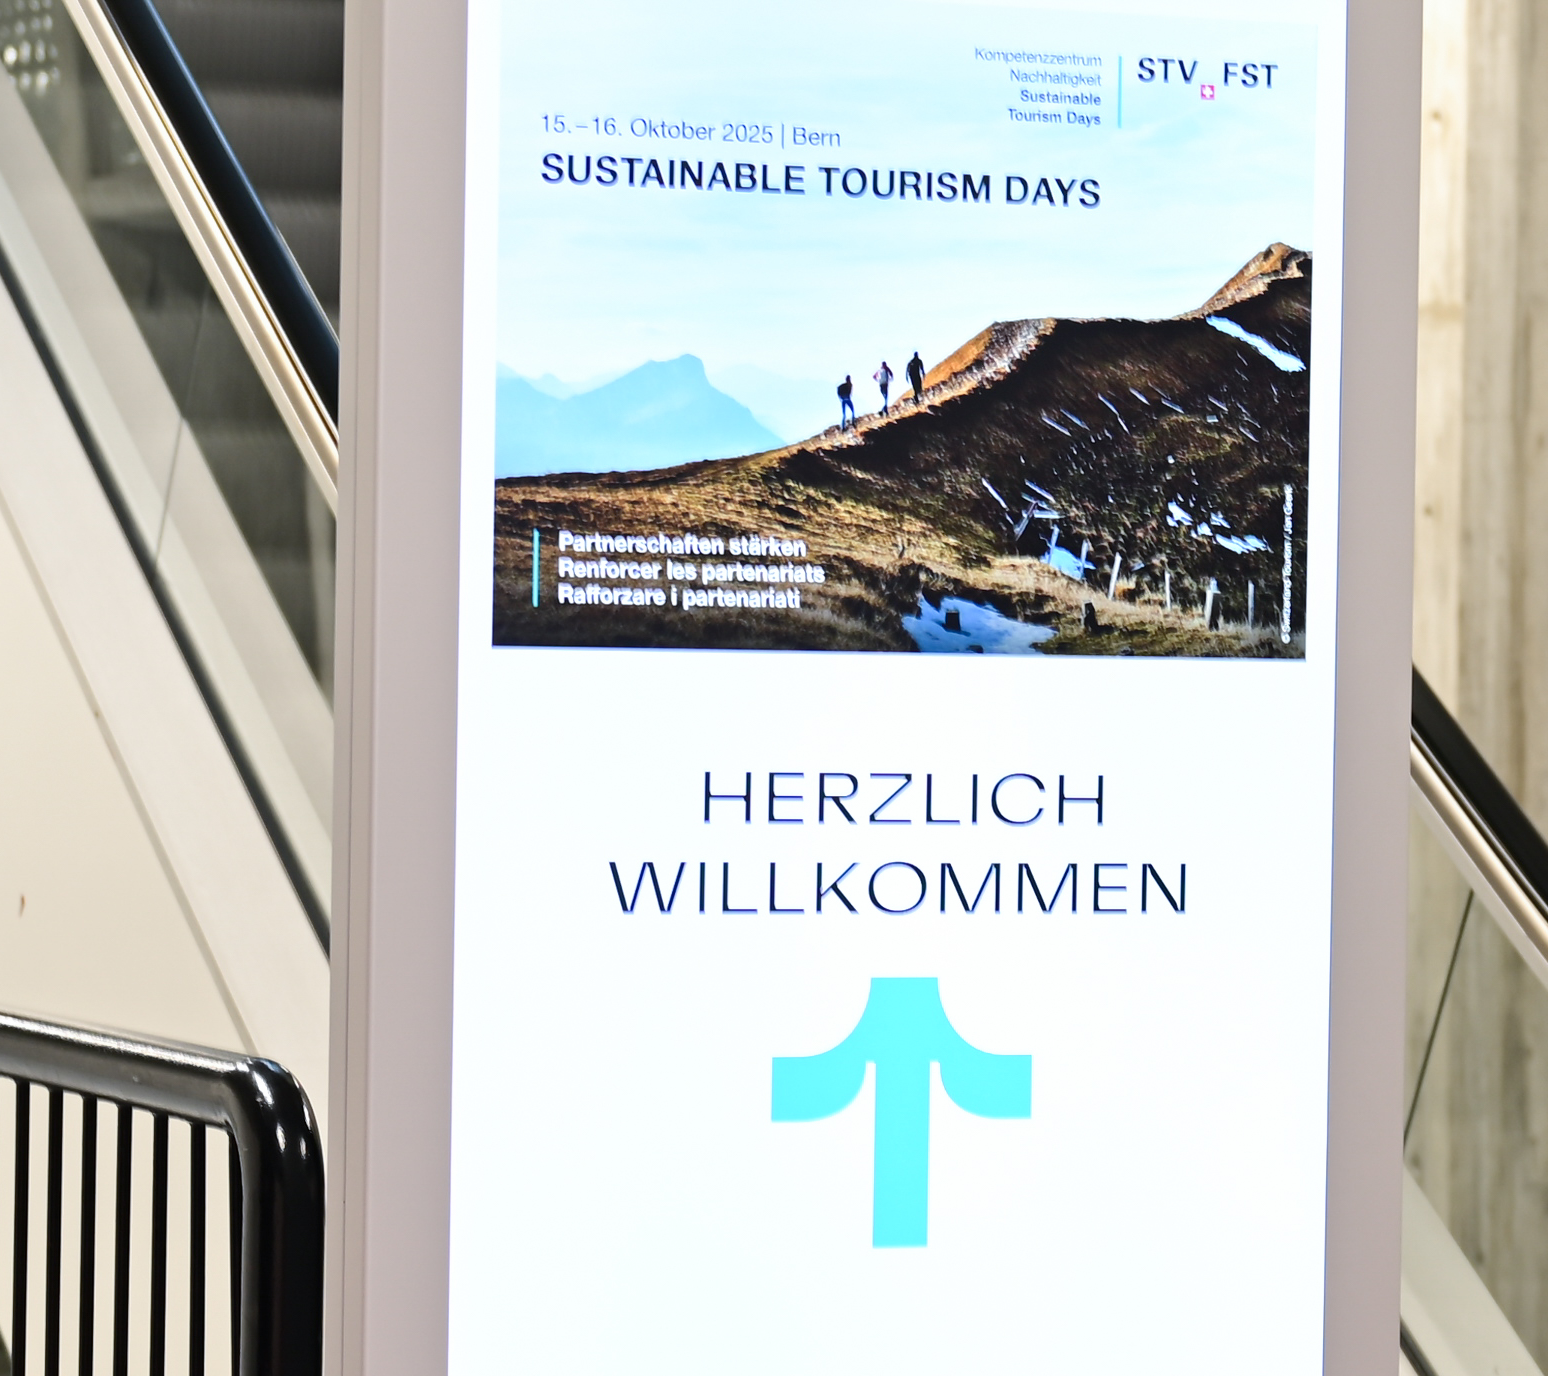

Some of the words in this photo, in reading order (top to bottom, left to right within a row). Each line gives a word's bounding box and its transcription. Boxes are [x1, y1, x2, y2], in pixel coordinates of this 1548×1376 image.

[974, 47, 1102, 68] Kompetenzzentrum
[1009, 69, 1102, 88] Nachhaltigkeit
[1137, 57, 1198, 84] STV
[1223, 62, 1279, 89] FST
[1020, 89, 1102, 106] Sustainable
[1008, 108, 1062, 124] Tourism
[1067, 111, 1101, 127] Days
[630, 118, 716, 141] Oktober
[722, 123, 774, 144] 2025
[793, 127, 841, 147] Bern
[541, 153, 805, 195] SUSTAINABLE
[818, 167, 991, 203] TOURISM
[1005, 176, 1102, 209] DAYS
[558, 529, 725, 556] Partnerschaften
[729, 535, 807, 557] stärken
[558, 556, 662, 580] Renforcer
[666, 559, 697, 581] les
[702, 563, 826, 585] partenariats
[558, 582, 666, 606] Rafforzare
[670, 584, 678, 607] i
[682, 586, 801, 610] partenariati
[704, 771, 1104, 827] HERZLICH
[609, 861, 1187, 915] WILLKOMMEN
